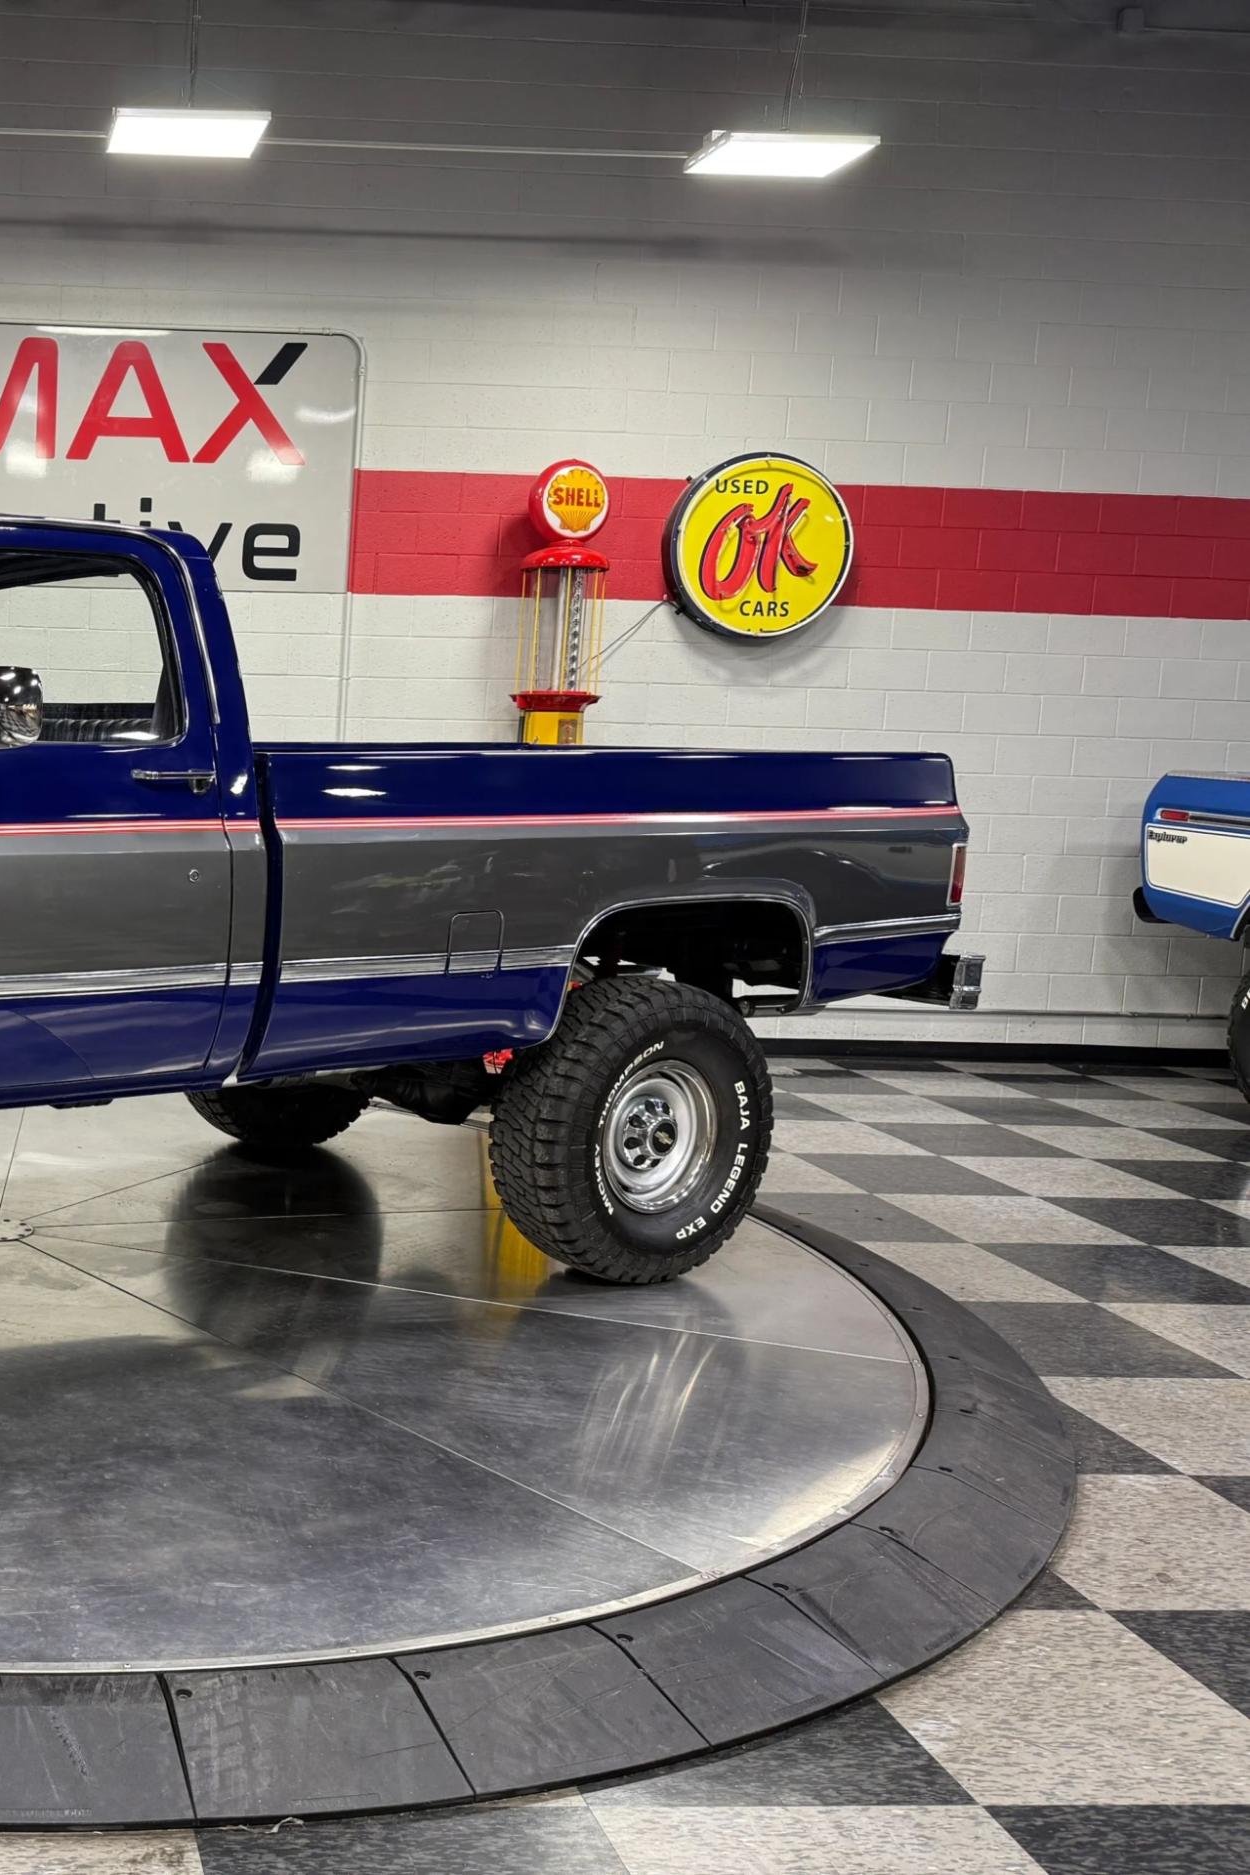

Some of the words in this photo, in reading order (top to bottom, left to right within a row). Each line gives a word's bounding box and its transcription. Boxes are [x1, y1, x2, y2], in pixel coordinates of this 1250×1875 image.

[552, 486, 601, 508] SHELL
[715, 479, 769, 495] USED
[698, 483, 819, 601] OK
[739, 600, 790, 617] CARS
[1148, 830, 1187, 843] Explorer
[598, 1041, 664, 1128] THOMPSON
[734, 1080, 751, 1131] BAJA
[710, 1142, 749, 1214] LEGEND
[675, 1216, 707, 1240] EXP
